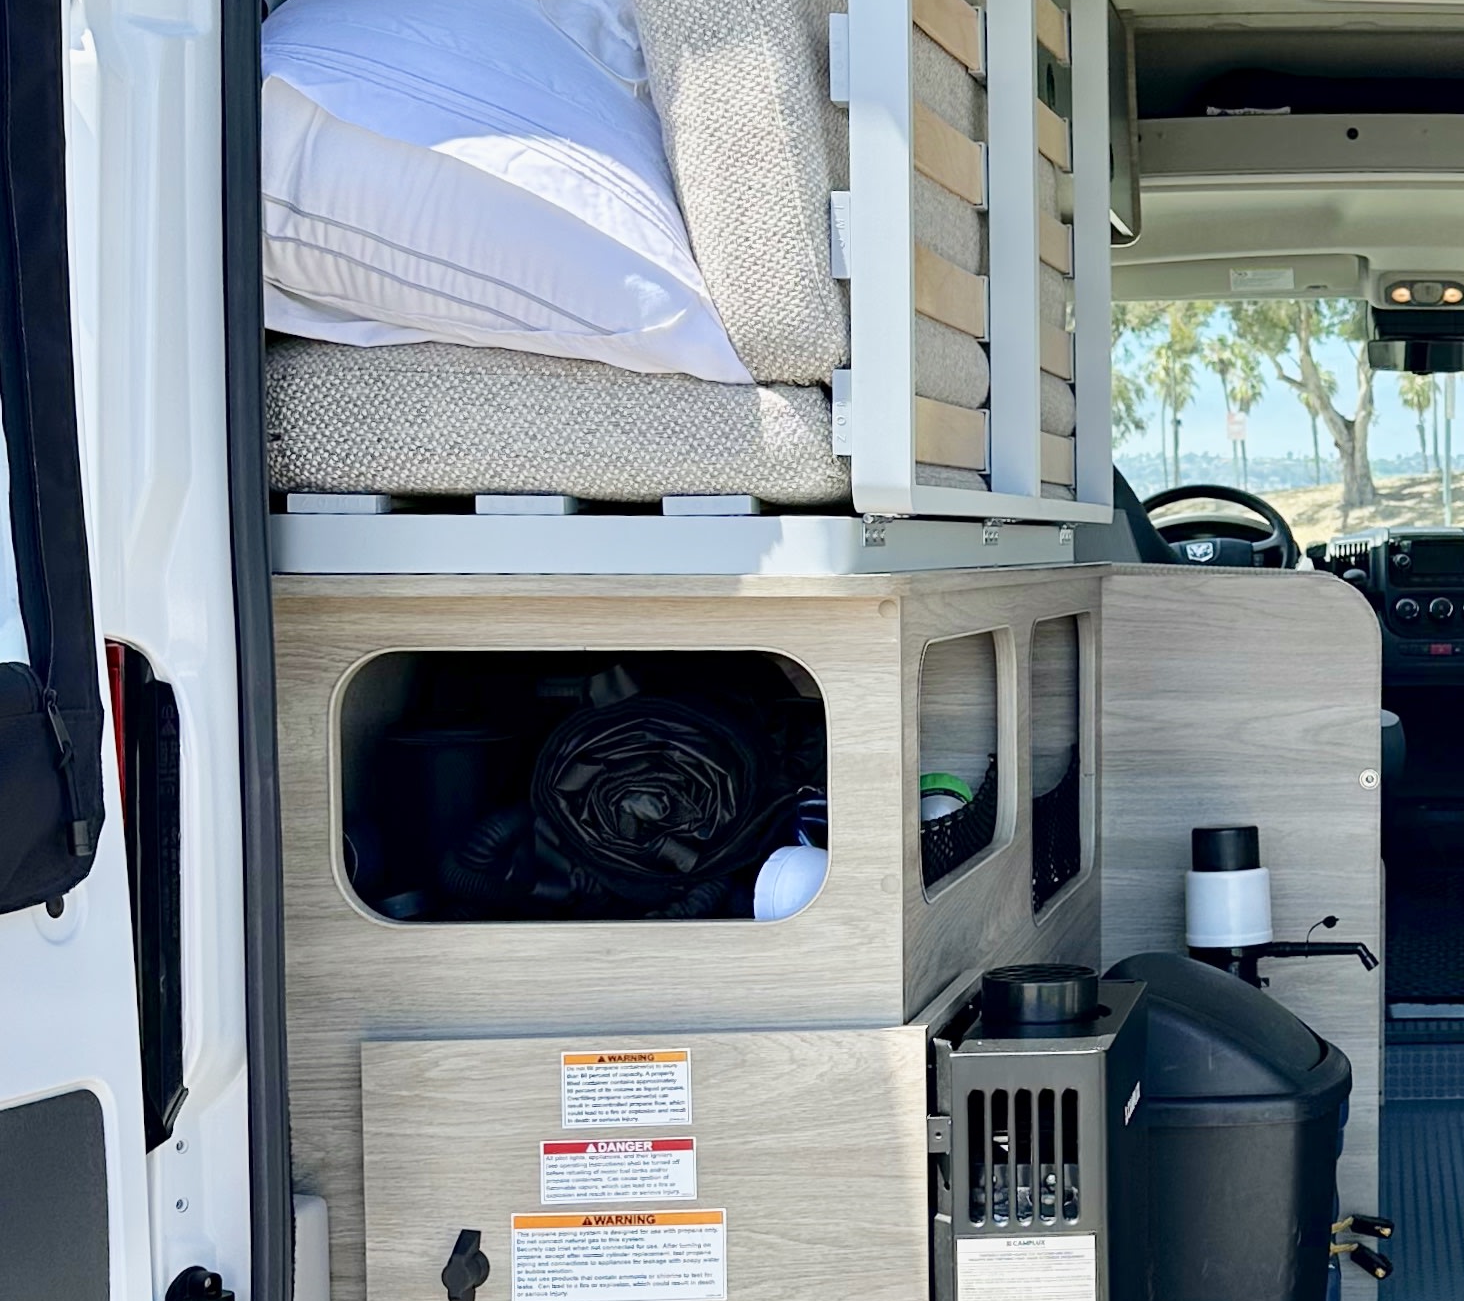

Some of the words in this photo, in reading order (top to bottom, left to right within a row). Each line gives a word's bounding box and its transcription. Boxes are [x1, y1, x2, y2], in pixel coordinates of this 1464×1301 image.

[607, 1054, 654, 1062] WARNING
[598, 1141, 652, 1152] DANGER
[594, 1215, 656, 1225] WARNING
